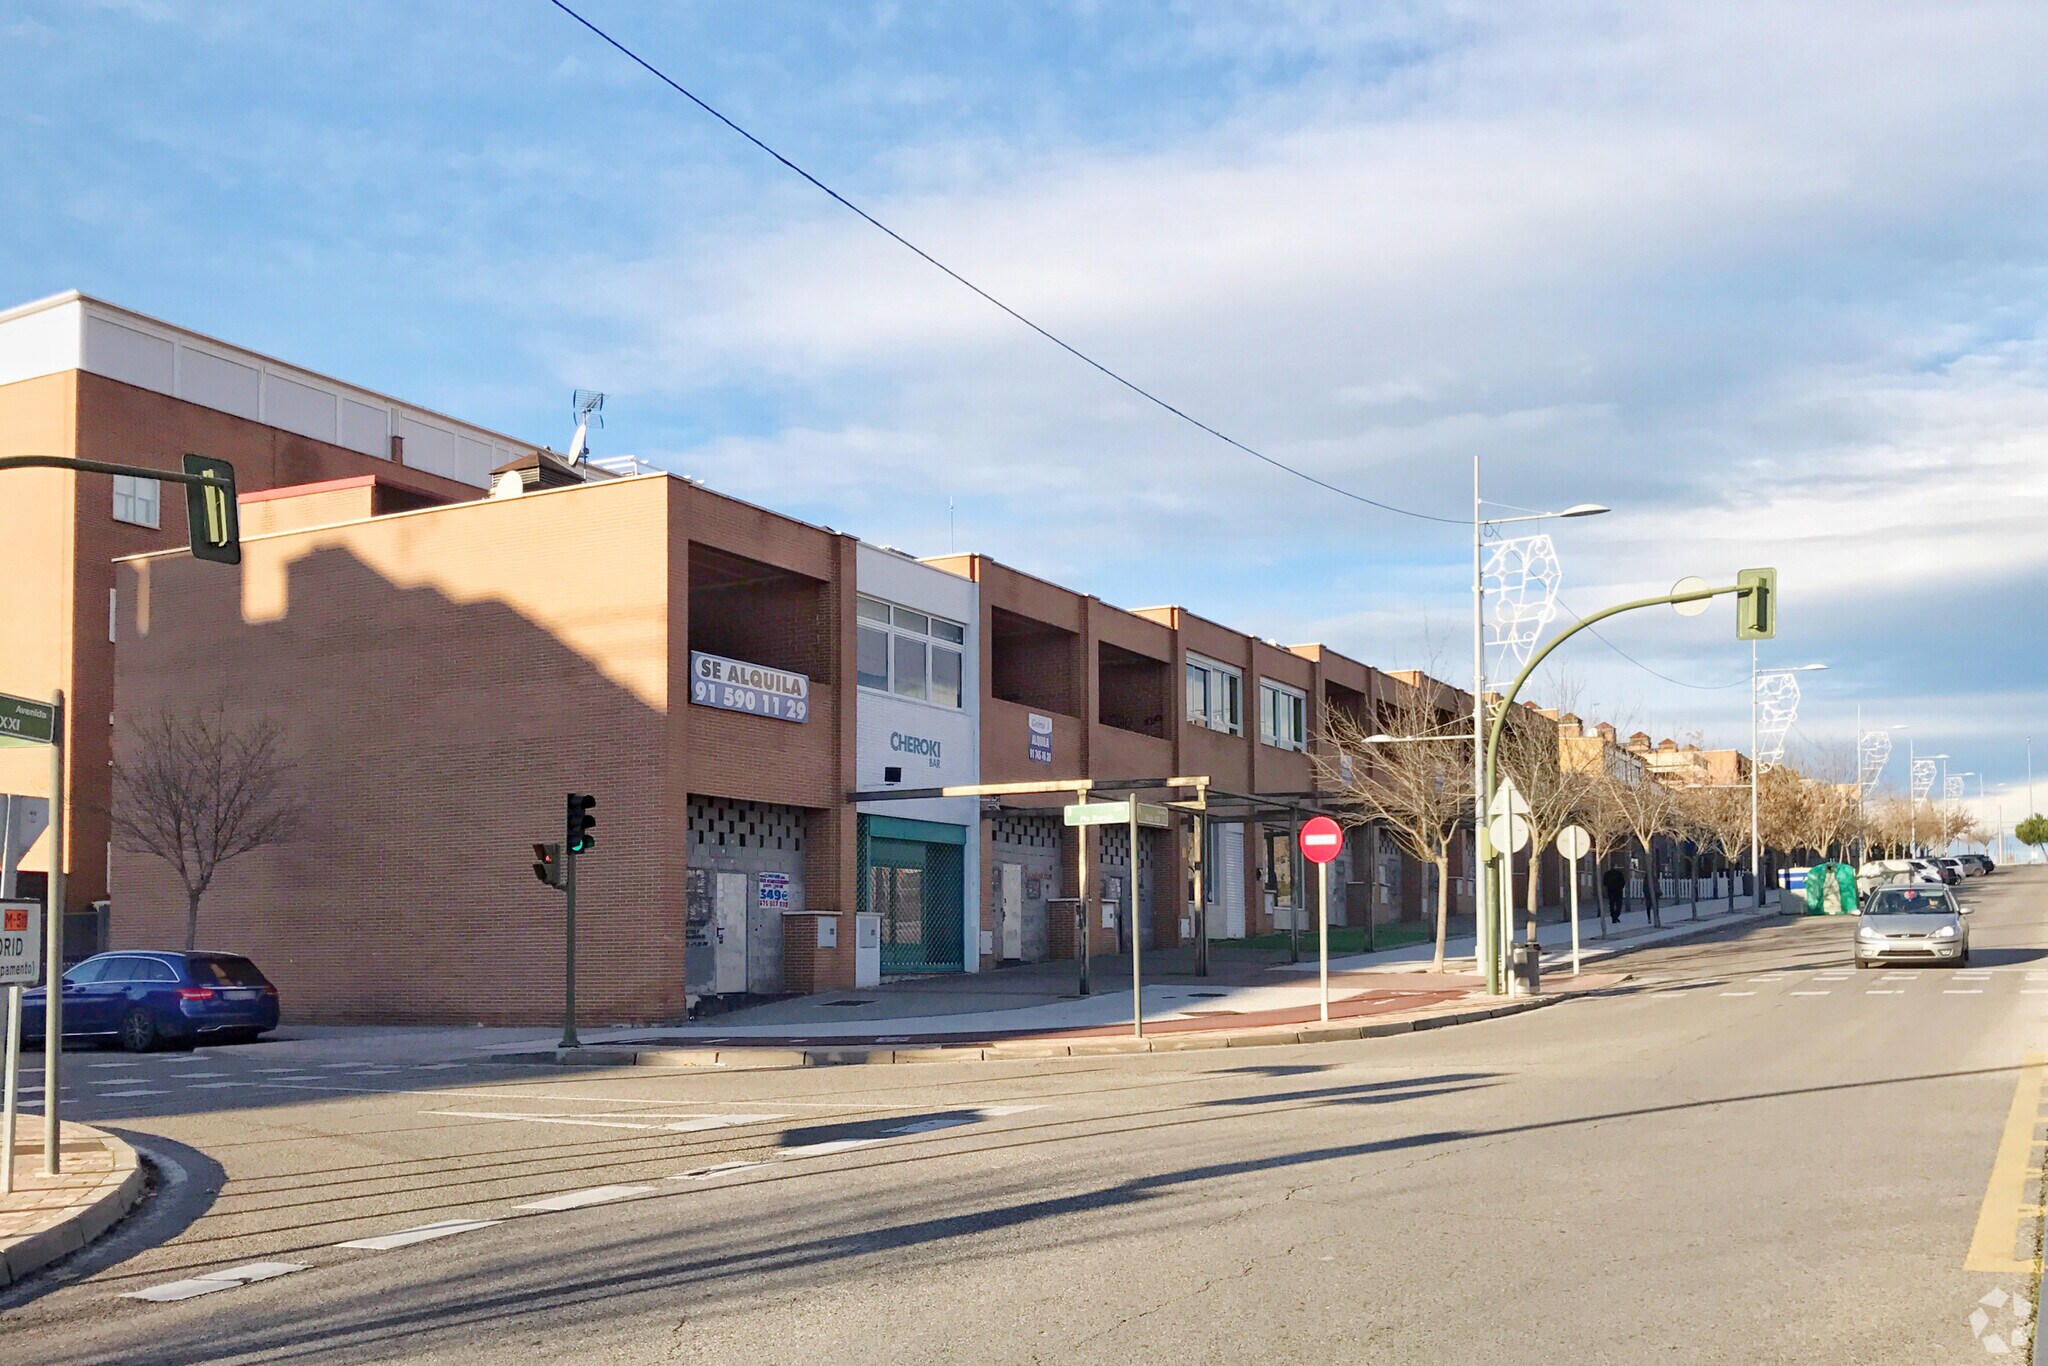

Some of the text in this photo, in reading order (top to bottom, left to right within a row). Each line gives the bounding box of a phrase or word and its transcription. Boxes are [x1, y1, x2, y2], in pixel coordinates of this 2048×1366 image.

[701, 659, 801, 696] SE ALQUILA
[695, 681, 806, 720] 91 590 11 29
[15, 705, 47, 719] Avenida
[890, 731, 941, 758] CHEROKI
[929, 758, 941, 768] BAR
[759, 889, 788, 900] 349€
